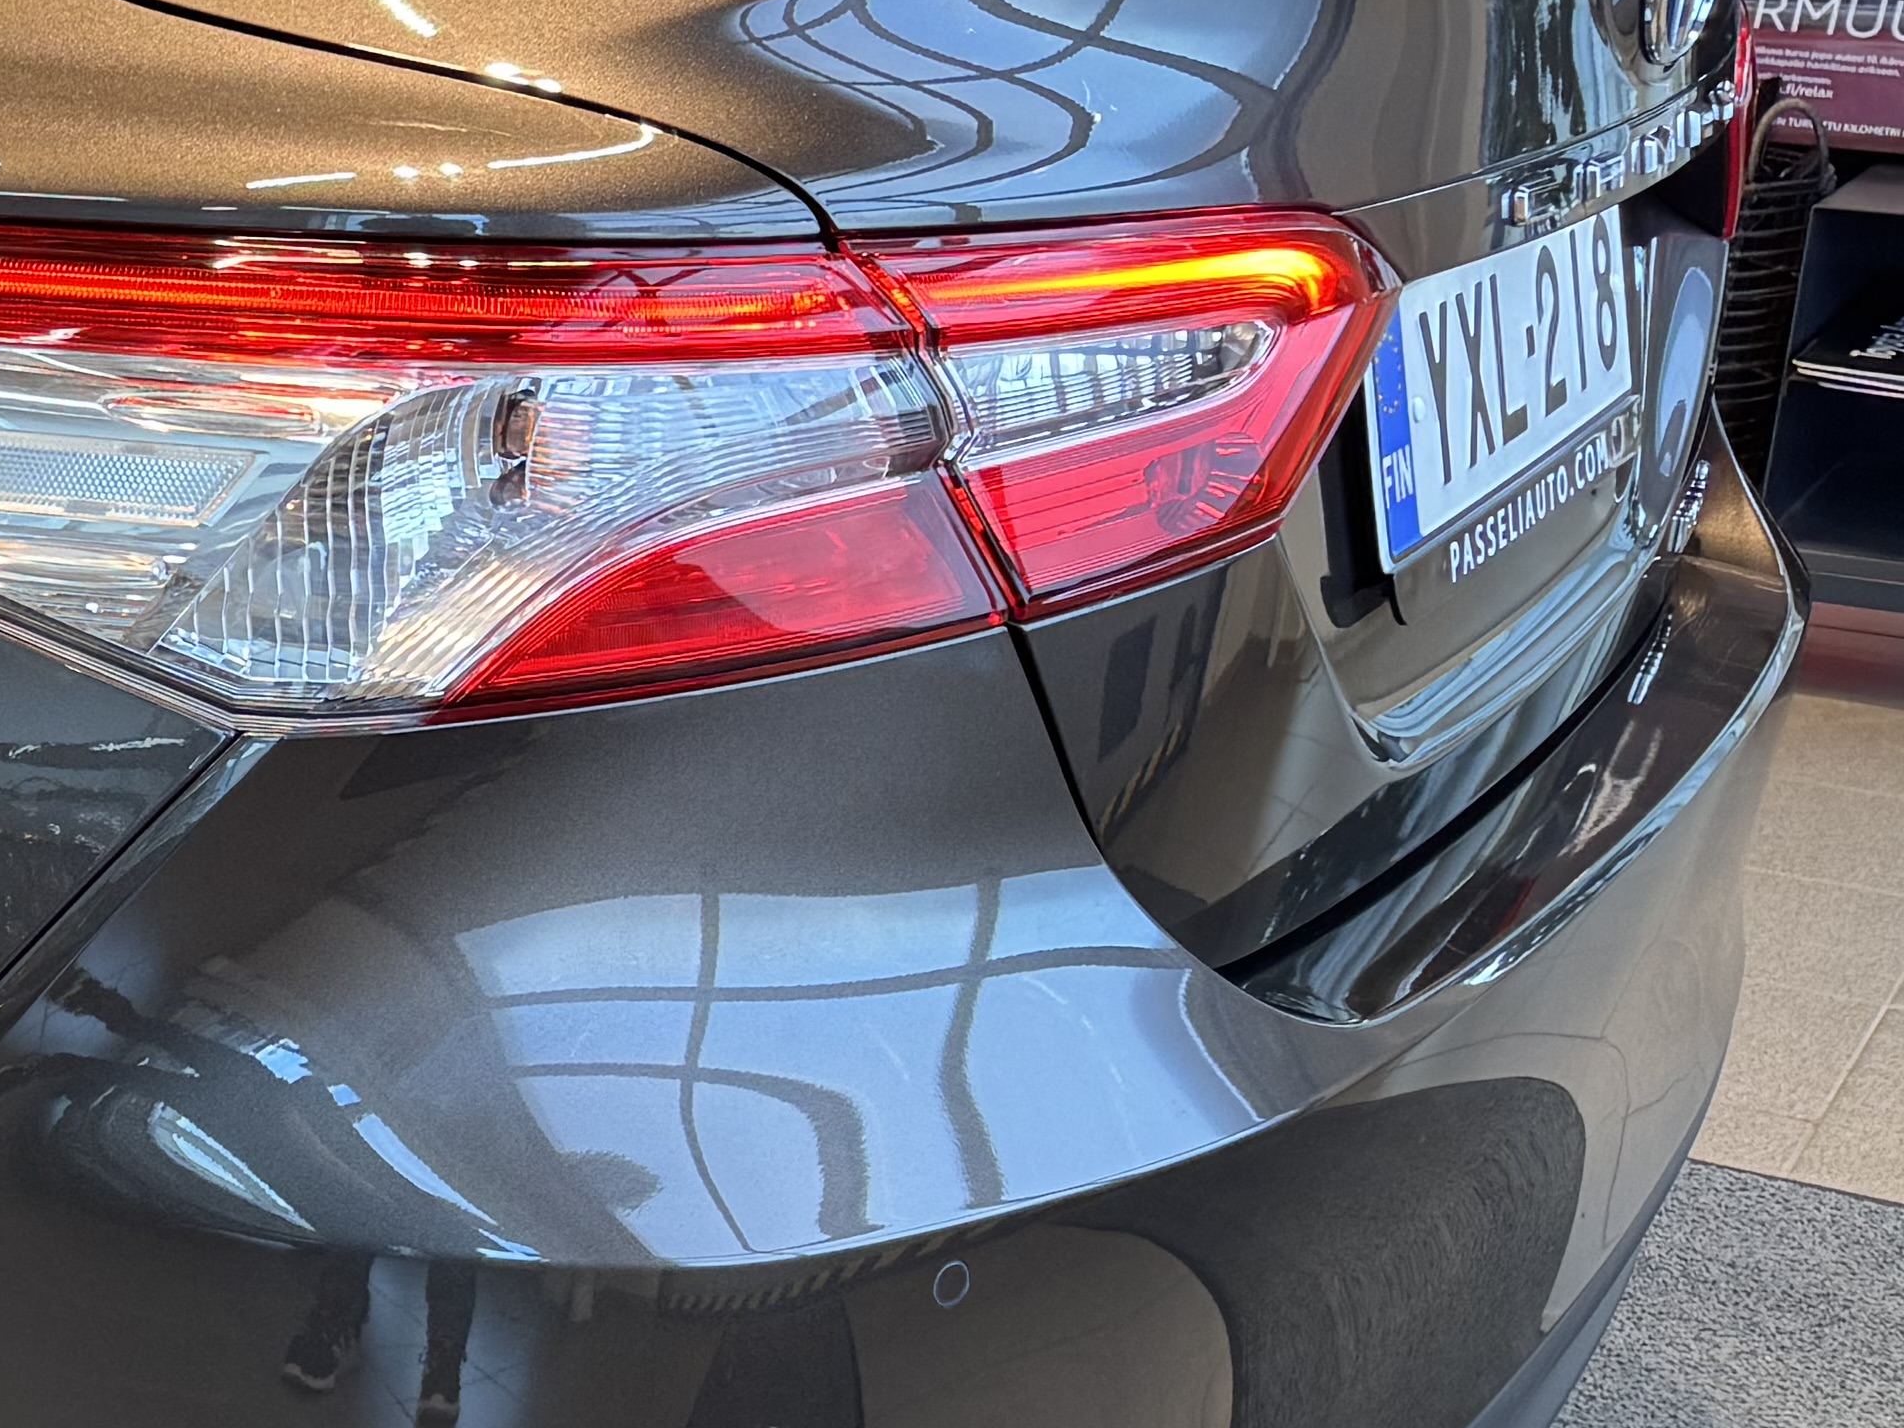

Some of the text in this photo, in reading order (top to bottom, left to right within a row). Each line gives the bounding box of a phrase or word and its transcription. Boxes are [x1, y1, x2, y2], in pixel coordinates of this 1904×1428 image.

[1418, 212, 1618, 486] YXL-218
[1382, 444, 1414, 509] FIN
[1449, 438, 1609, 583] PASSELIAUTO.COM
